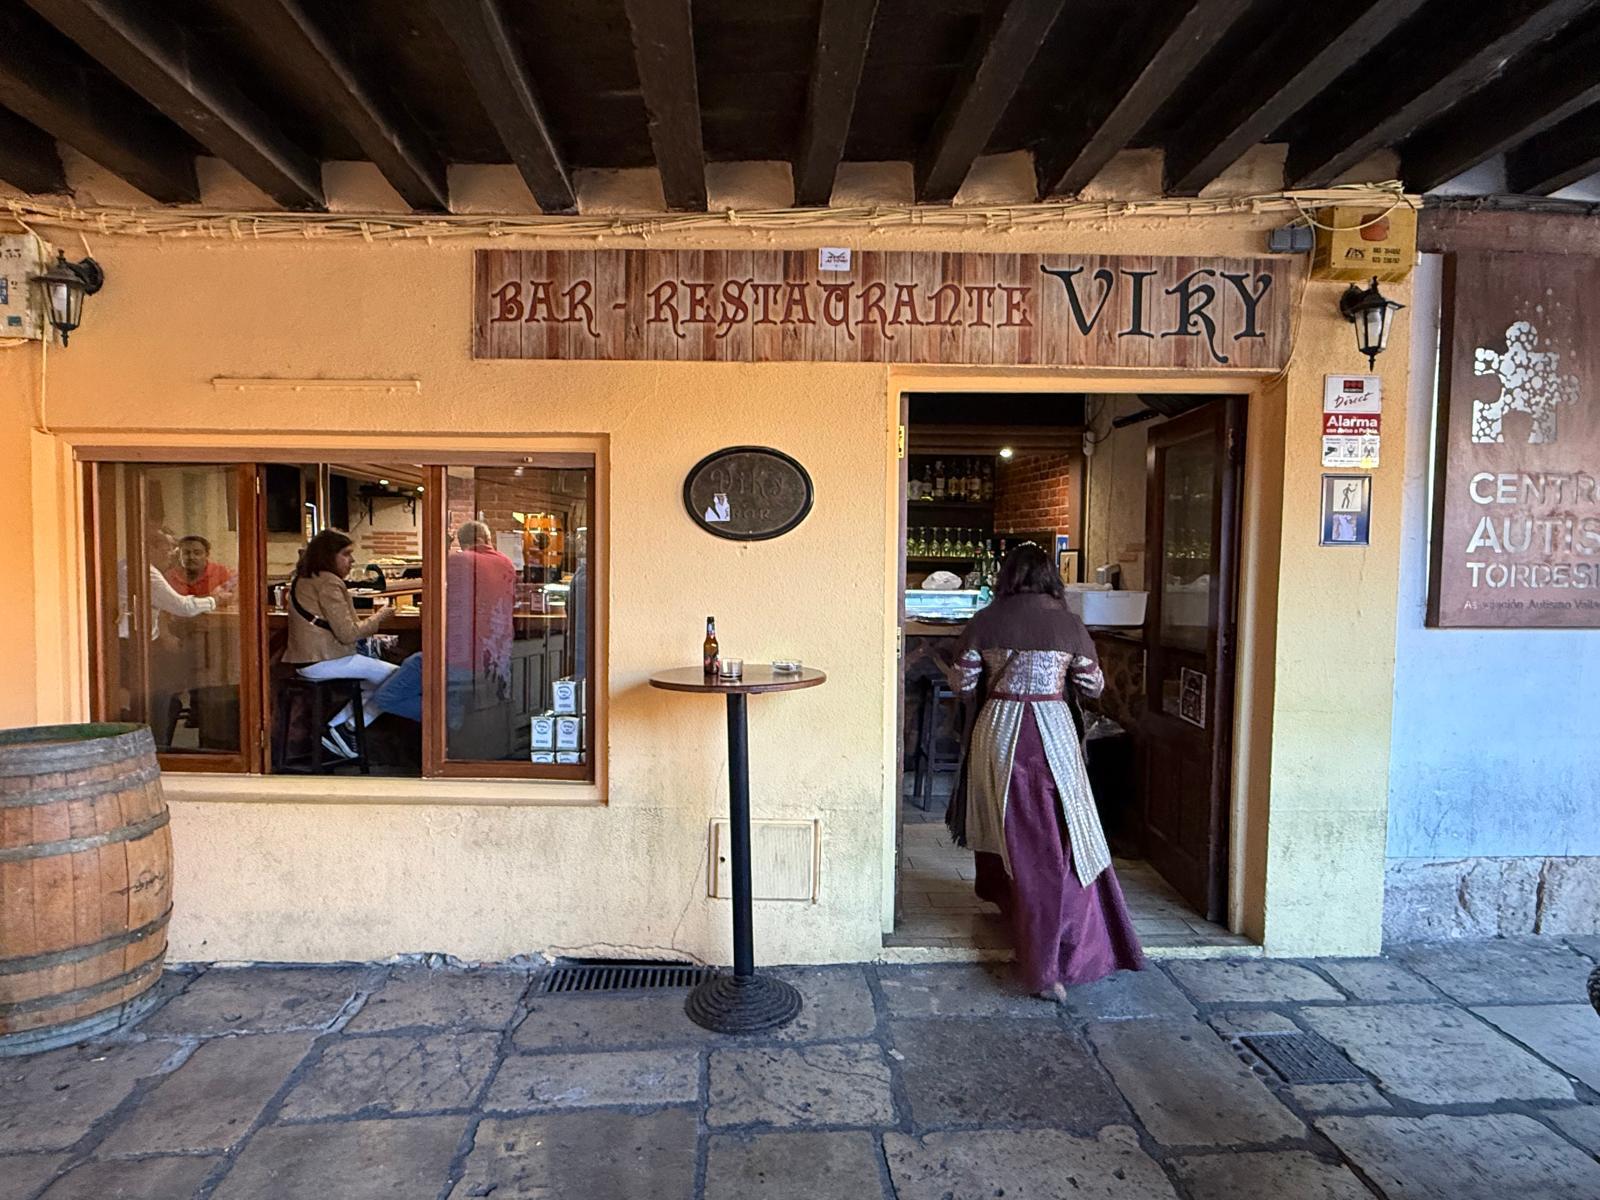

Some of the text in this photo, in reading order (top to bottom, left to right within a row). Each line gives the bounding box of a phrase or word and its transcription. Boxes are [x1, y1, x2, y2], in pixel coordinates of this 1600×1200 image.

[491, 280, 600, 338] BAR
[646, 278, 1032, 339] RESTAURANTE
[1040, 264, 1272, 364] VIKY
[1326, 415, 1378, 427] Alarma
[1469, 472, 1600, 505] CENTR
